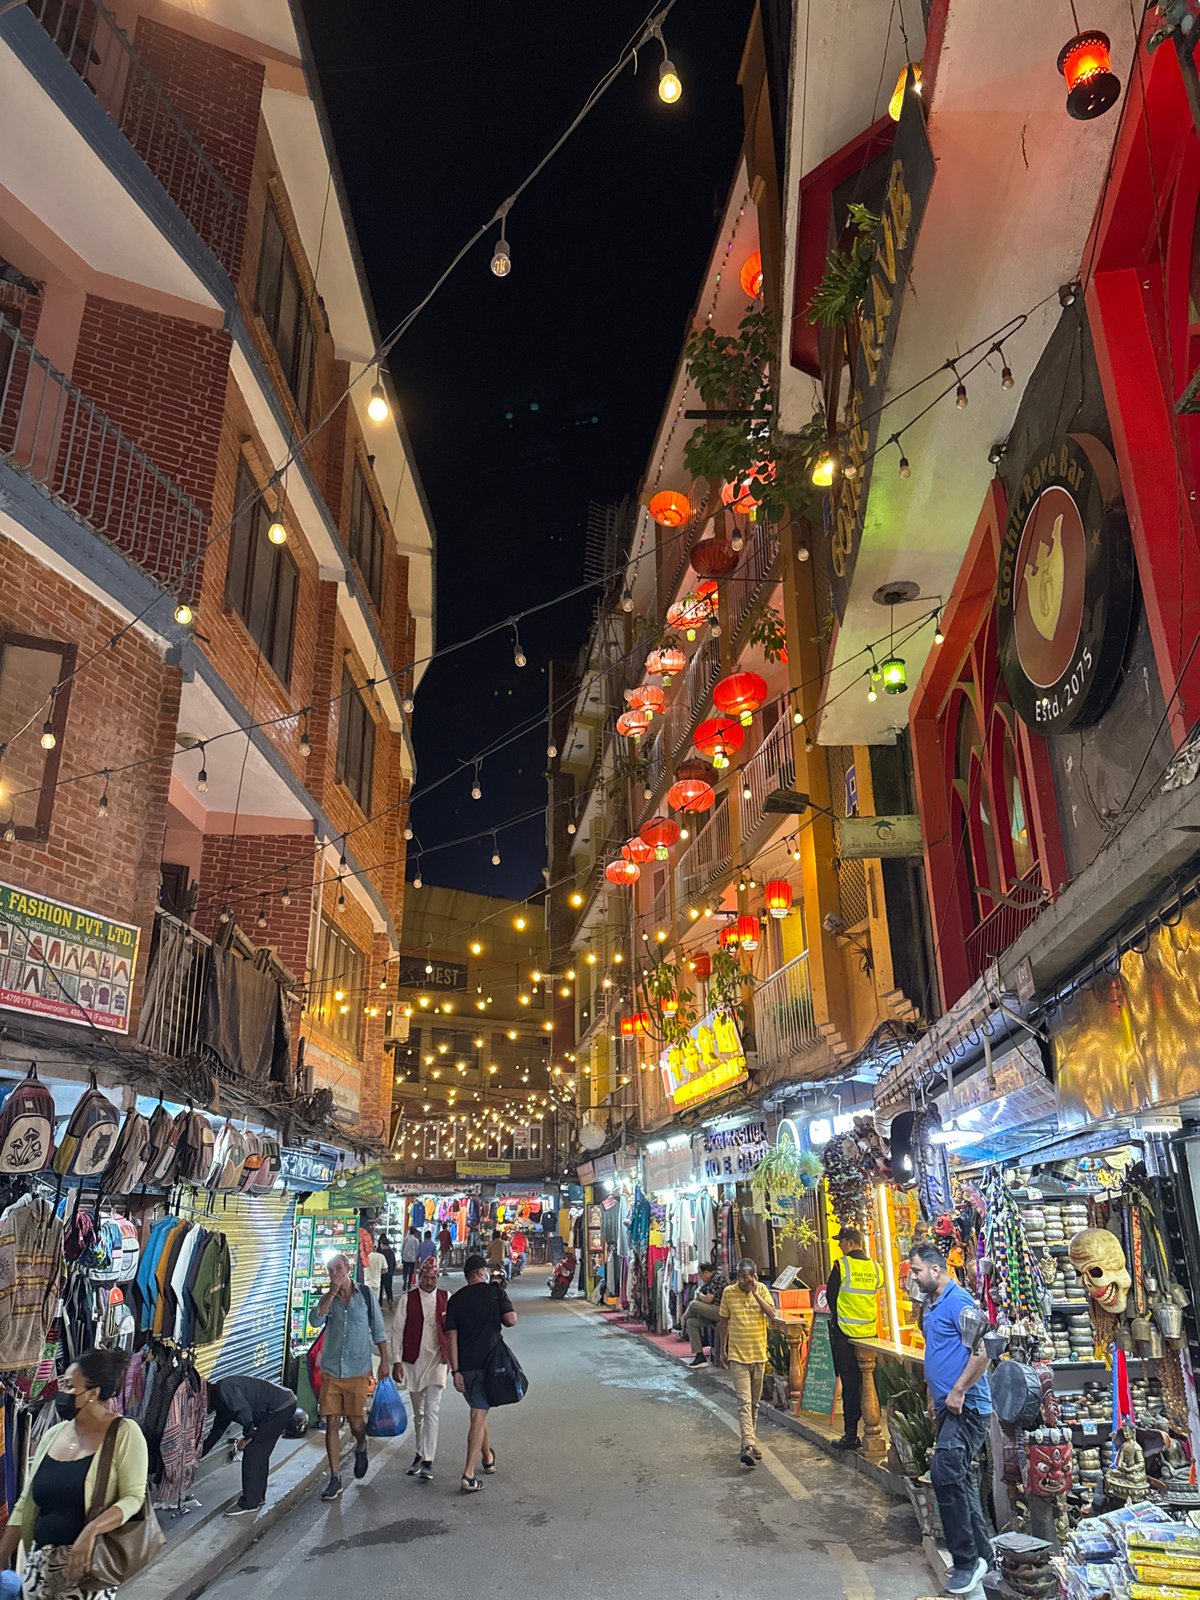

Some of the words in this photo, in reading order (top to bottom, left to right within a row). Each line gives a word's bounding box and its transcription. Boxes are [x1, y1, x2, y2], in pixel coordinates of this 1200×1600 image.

[999, 503, 1025, 606] Gothic
[1022, 453, 1056, 504] Rave
[1059, 444, 1084, 491] Bar
[1035, 694, 1063, 721] Estd.
[1063, 646, 1092, 706] 2075
[9, 892, 73, 929] FASHION
[75, 914, 104, 938] PVT.
[107, 924, 134, 948] LTD.
